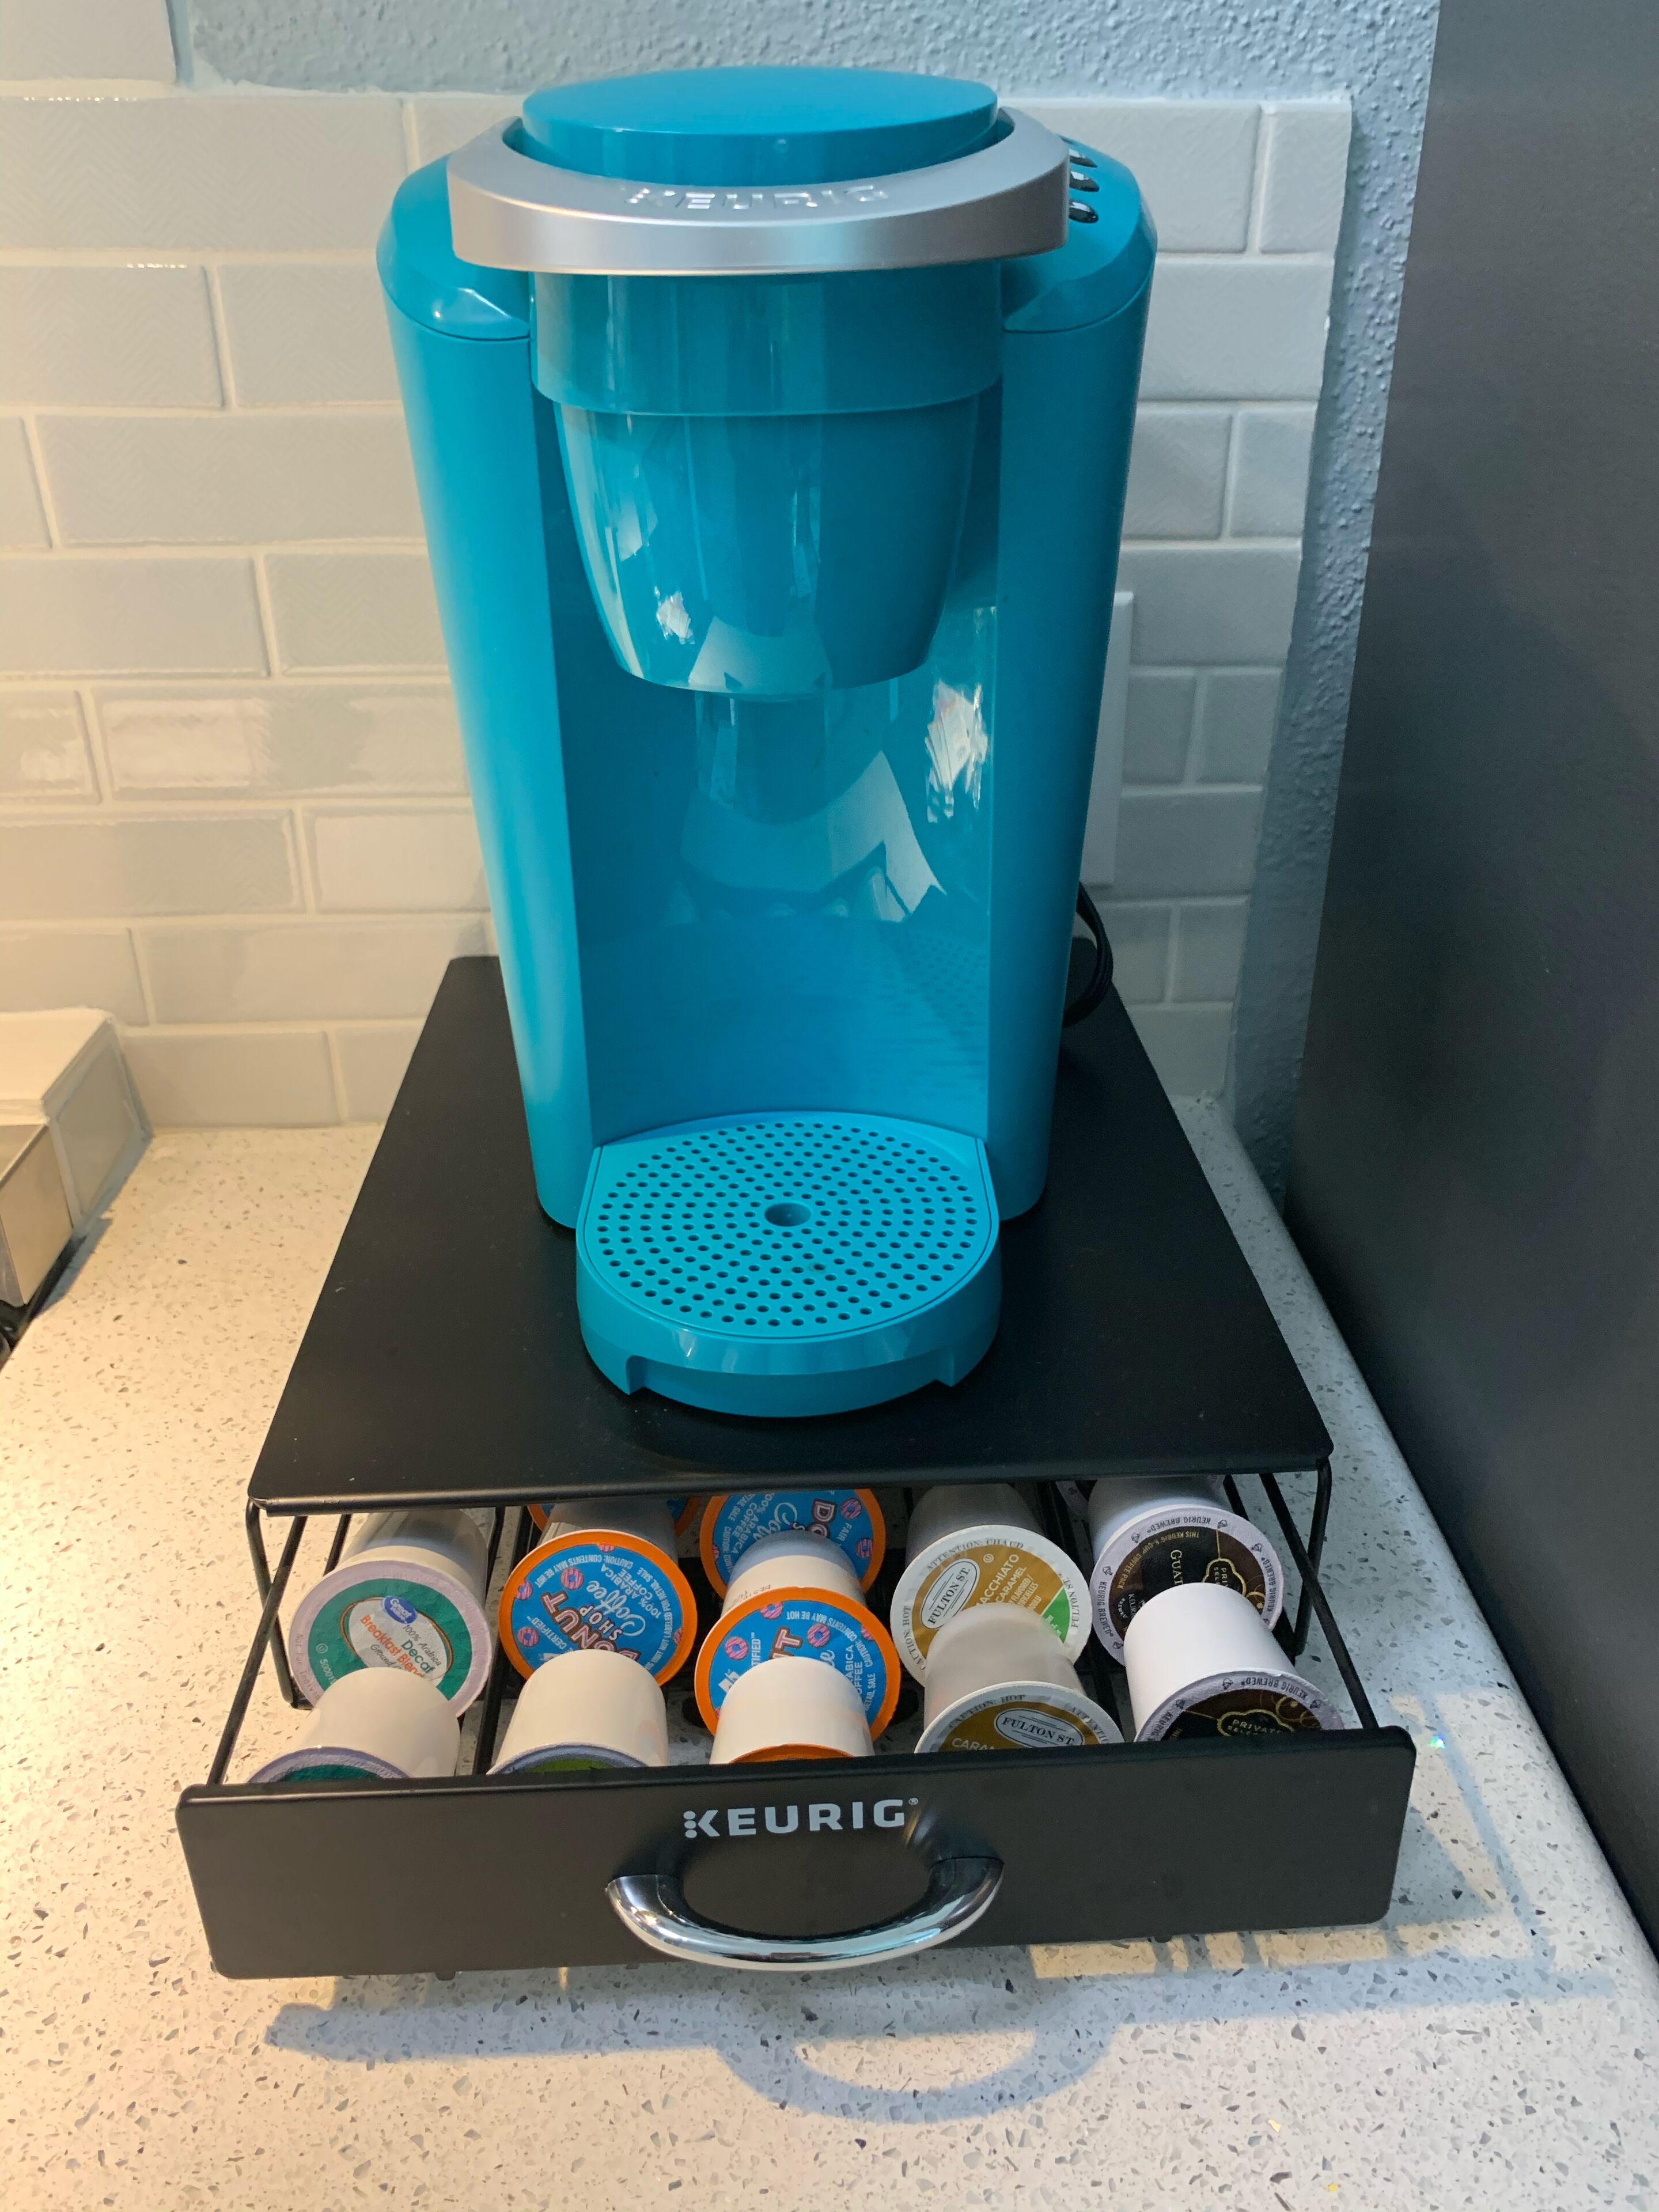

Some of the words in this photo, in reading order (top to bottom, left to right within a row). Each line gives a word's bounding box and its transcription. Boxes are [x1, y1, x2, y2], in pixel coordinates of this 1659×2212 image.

[621, 184, 888, 210] KEURIG
[732, 1502, 757, 1537] COFFEE
[836, 1522, 852, 1541] FAIR
[1184, 1516, 1211, 1524] KEURIG
[730, 1514, 759, 1554] ARABICA
[553, 1560, 568, 1573] MAY
[567, 1554, 603, 1566] CONTENTS
[927, 1540, 983, 1571] ATTENTION:
[544, 1568, 555, 1579] BE
[601, 1563, 641, 1599] ARABICA
[618, 1568, 653, 1600] COFFEE
[637, 1567, 654, 1582] SALE
[976, 1554, 1019, 1604] ACCHIATO
[995, 1566, 1027, 1603] CARAMEL
[927, 1582, 960, 1624] FULTON
[956, 1567, 971, 1582] ST.
[1097, 1581, 1108, 1605] KEURIG
[1267, 1588, 1277, 1612] KEURIG
[586, 1580, 646, 1637] Coffee
[638, 1598, 661, 1619] 100%
[786, 1611, 800, 1620] HOT
[801, 1611, 810, 1620] BE
[811, 1613, 828, 1624] MAY
[903, 1605, 911, 1626] HOT
[1068, 1591, 1080, 1628] FULTON
[579, 1605, 623, 1641] SHOP
[827, 1618, 858, 1642] CONTENTS
[359, 1615, 403, 1656] Breakfast
[403, 1624, 422, 1642] 100%
[418, 1643, 442, 1666] Arabica
[370, 1644, 397, 1666] Ground
[401, 1639, 436, 1673] Decaf
[845, 1645, 854, 1681] ABICA
[854, 1661, 863, 1695] OFFEE
[1001, 1694, 1025, 1703] HOT
[1281, 1682, 1308, 1699] KEURIG
[1001, 1717, 1055, 1738] FULTON
[952, 1738, 995, 1751] CARA
